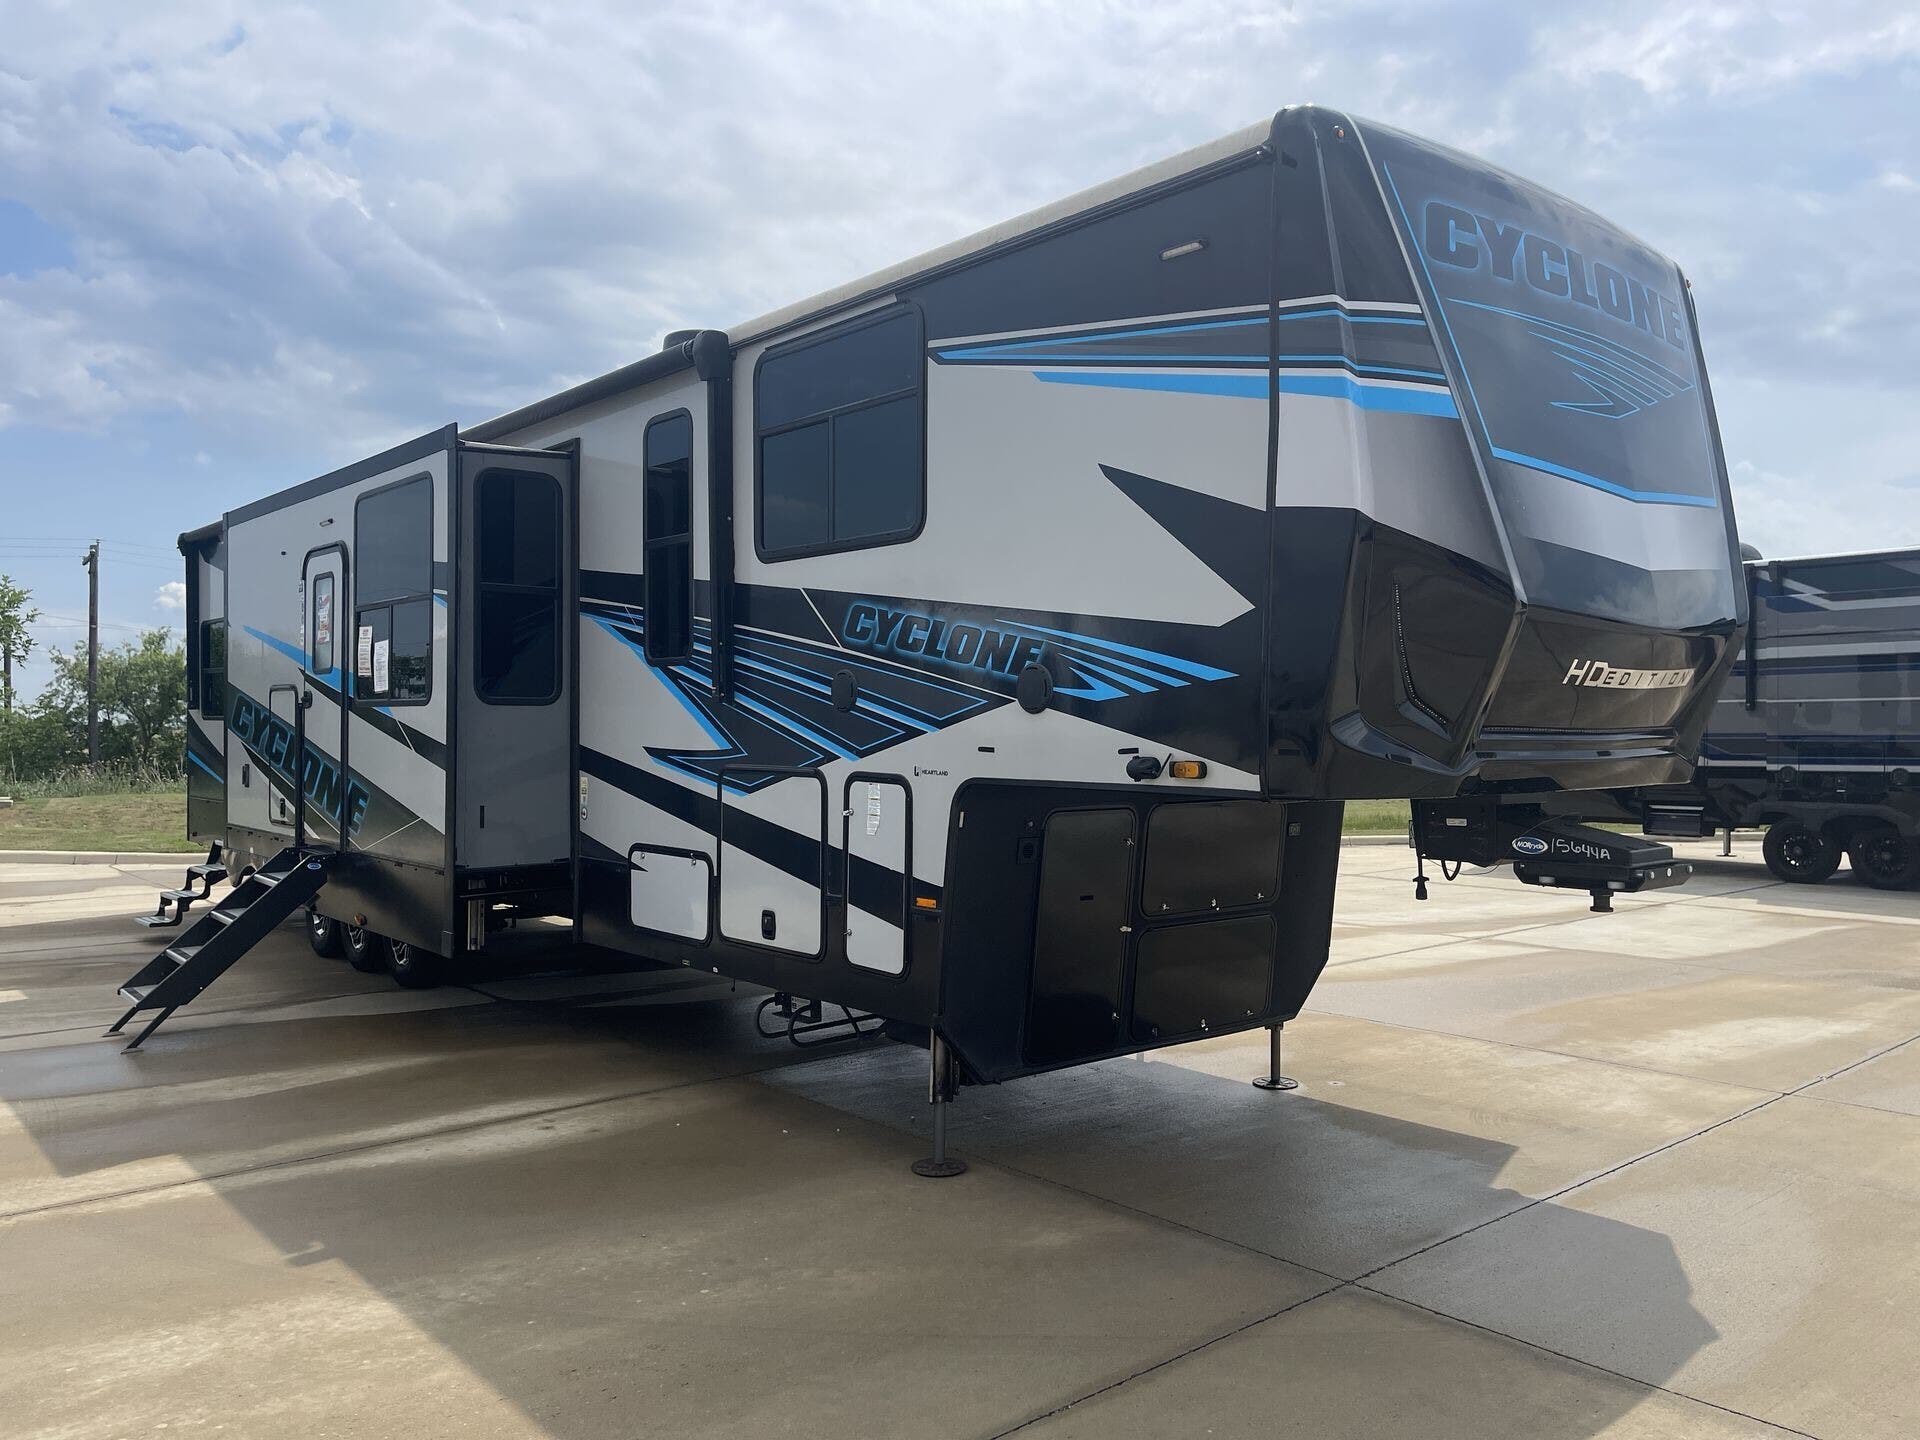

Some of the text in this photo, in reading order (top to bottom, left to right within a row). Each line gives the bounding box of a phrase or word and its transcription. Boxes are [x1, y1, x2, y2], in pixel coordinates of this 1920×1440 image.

[1424, 200, 1685, 351] CYCLONE
[844, 602, 1047, 678] CYCLONE
[1562, 658, 1690, 687] HD EDITION
[921, 768, 949, 777] HEARTLAND
[1551, 838, 1611, 860] 15644A
